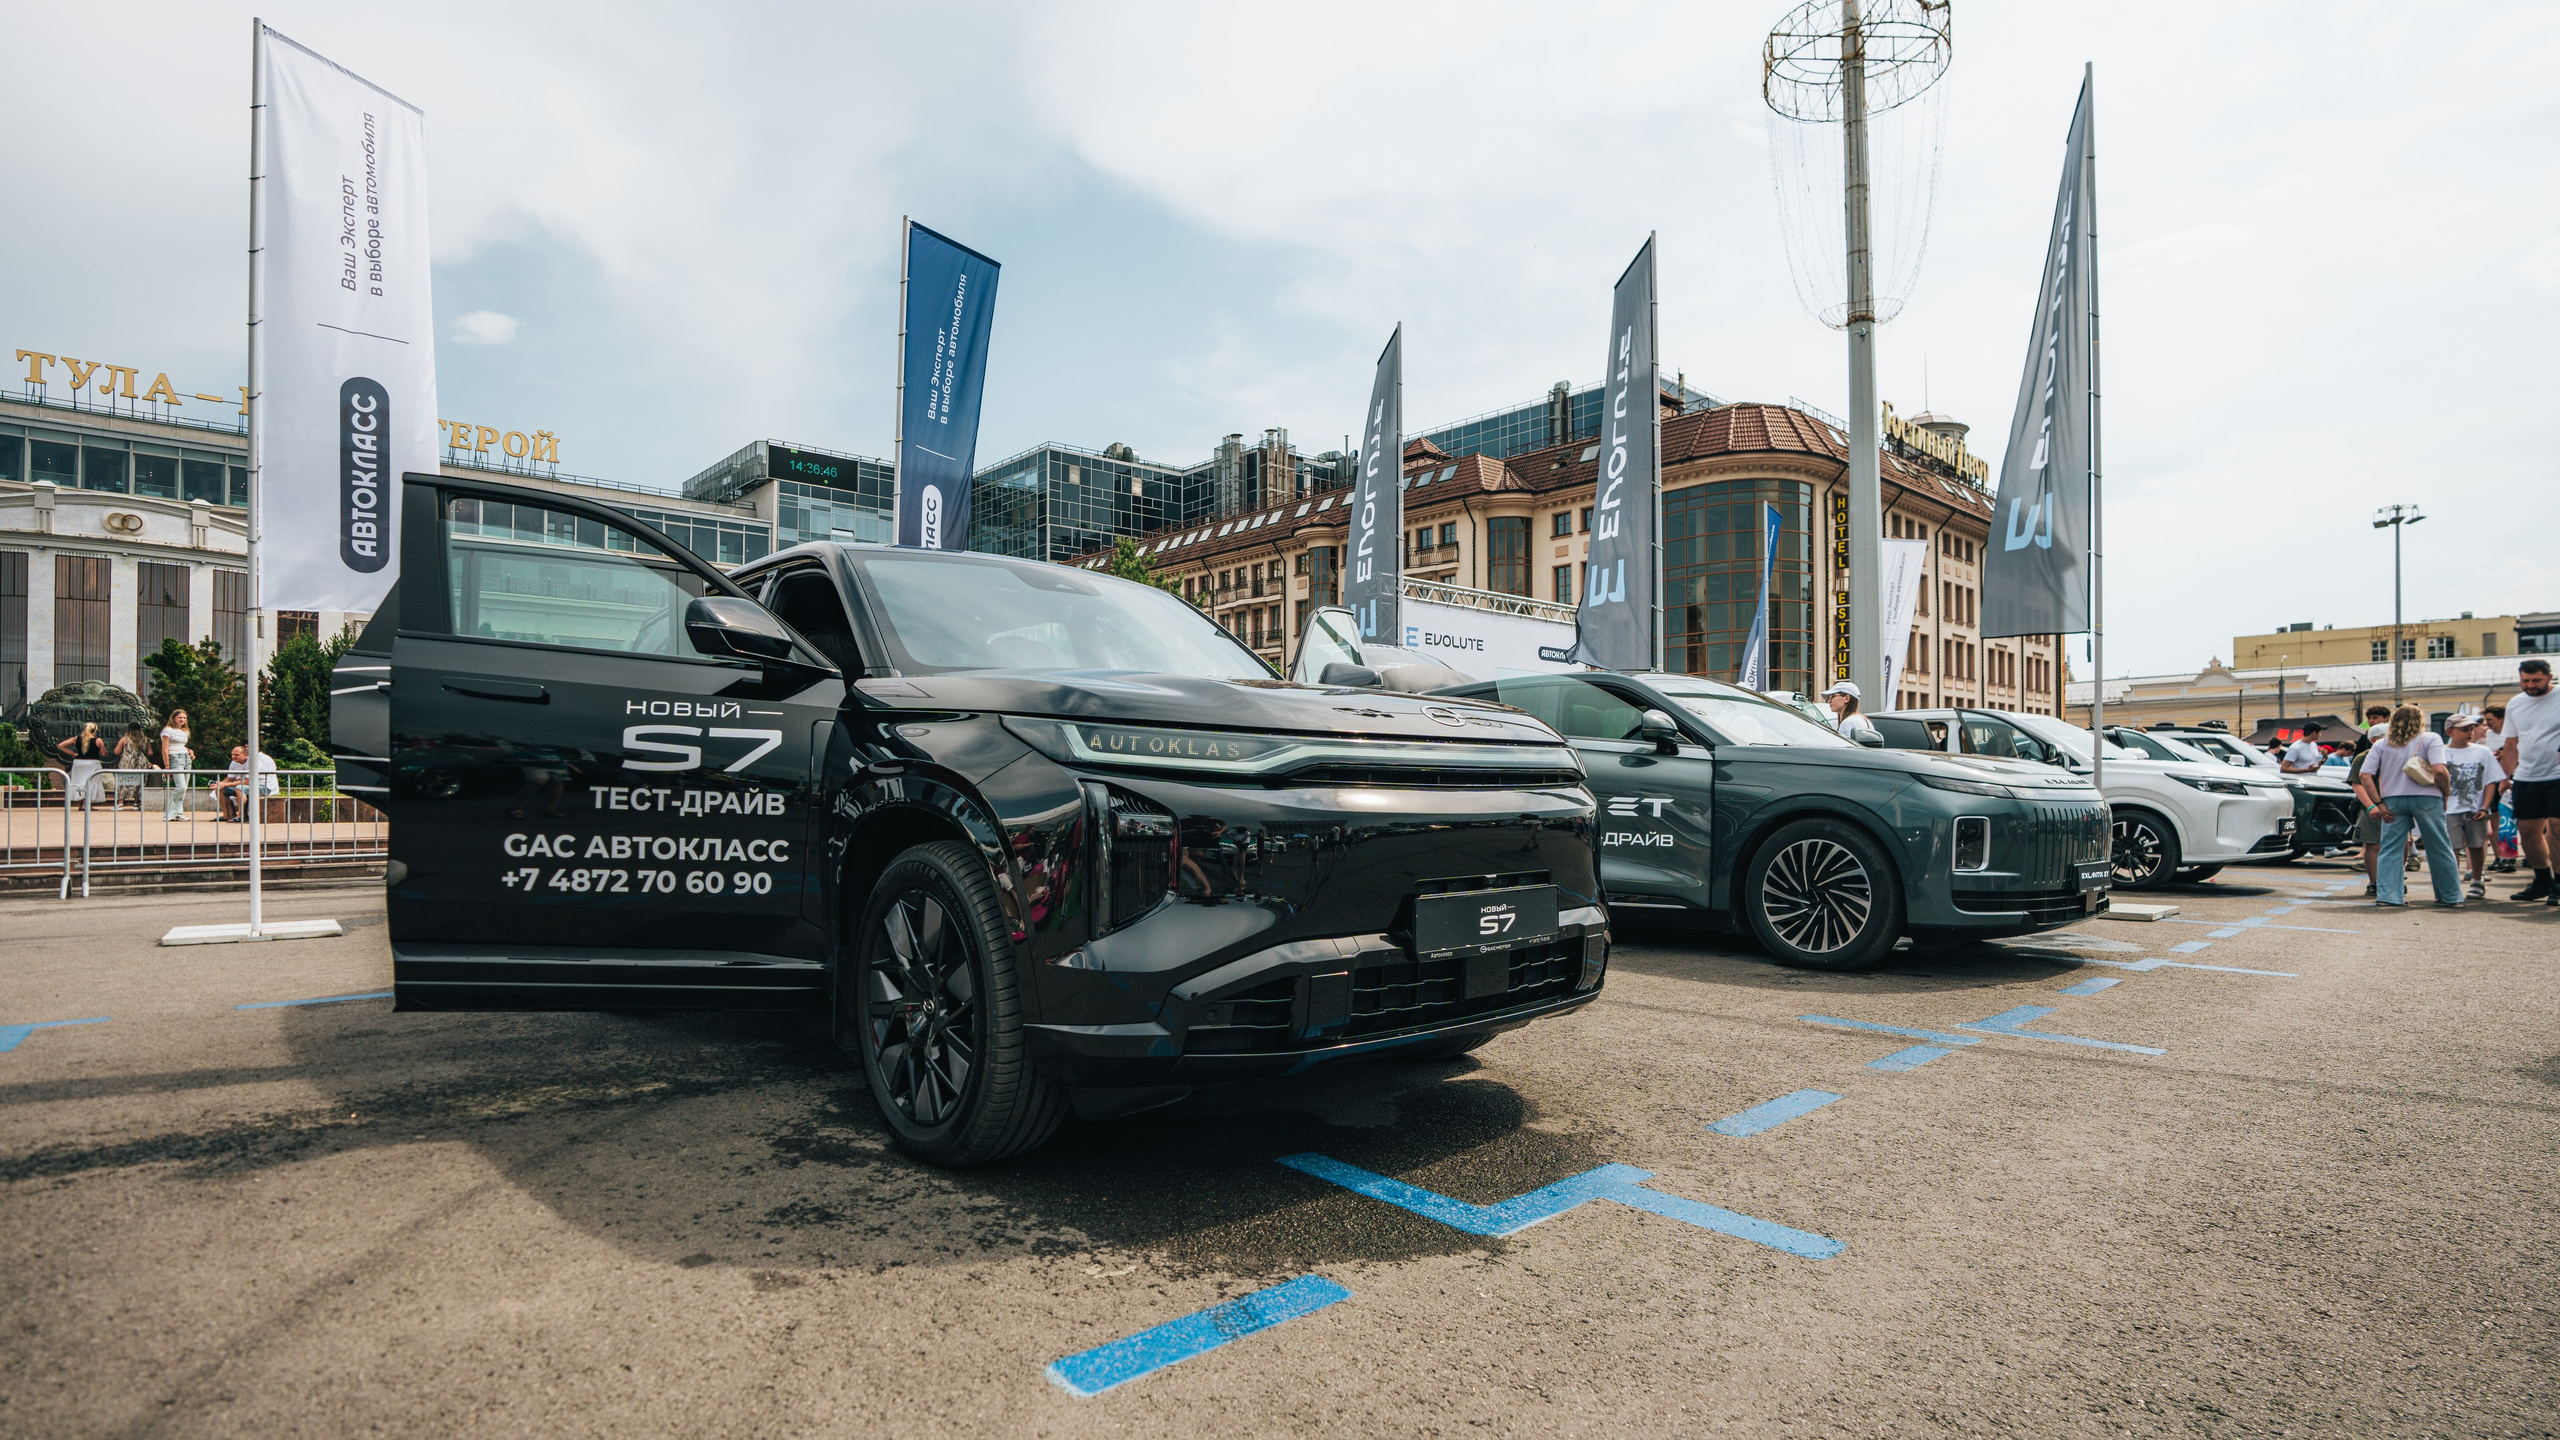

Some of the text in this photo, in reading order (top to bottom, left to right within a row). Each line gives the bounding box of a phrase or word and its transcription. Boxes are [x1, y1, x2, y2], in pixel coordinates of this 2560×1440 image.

[362, 111, 385, 297] в выборе автомобиля
[341, 174, 357, 292] Ваш Эксперт
[941, 361, 955, 414] выборе
[948, 273, 968, 357] автомобиля
[16, 349, 182, 405] ТУЛА
[927, 327, 947, 420] Ваш Эксперт
[1882, 400, 1989, 489] Гостиный Двор
[351, 392, 378, 557] АВТОКЛАСС
[789, 459, 838, 478] 14:36:46
[1836, 497, 1847, 568] HOTEL
[1425, 633, 1484, 651] EVOLUTE
[1541, 649, 1566, 660] АВТОКЛ
[626, 700, 741, 719] НОВЫЙ
[621, 724, 783, 773] S7
[1090, 733, 1241, 758] AUTOKLAS
[589, 786, 786, 817] ТЕСТ-ДРАЙВ
[503, 833, 790, 863] GAC АВТОКЛАСС
[1600, 831, 1674, 847] -ДРАЙВ
[501, 868, 773, 895] +7 4872 70 60 90
[1480, 904, 1507, 913] НОВЫЙ
[1480, 913, 1516, 935] S7
